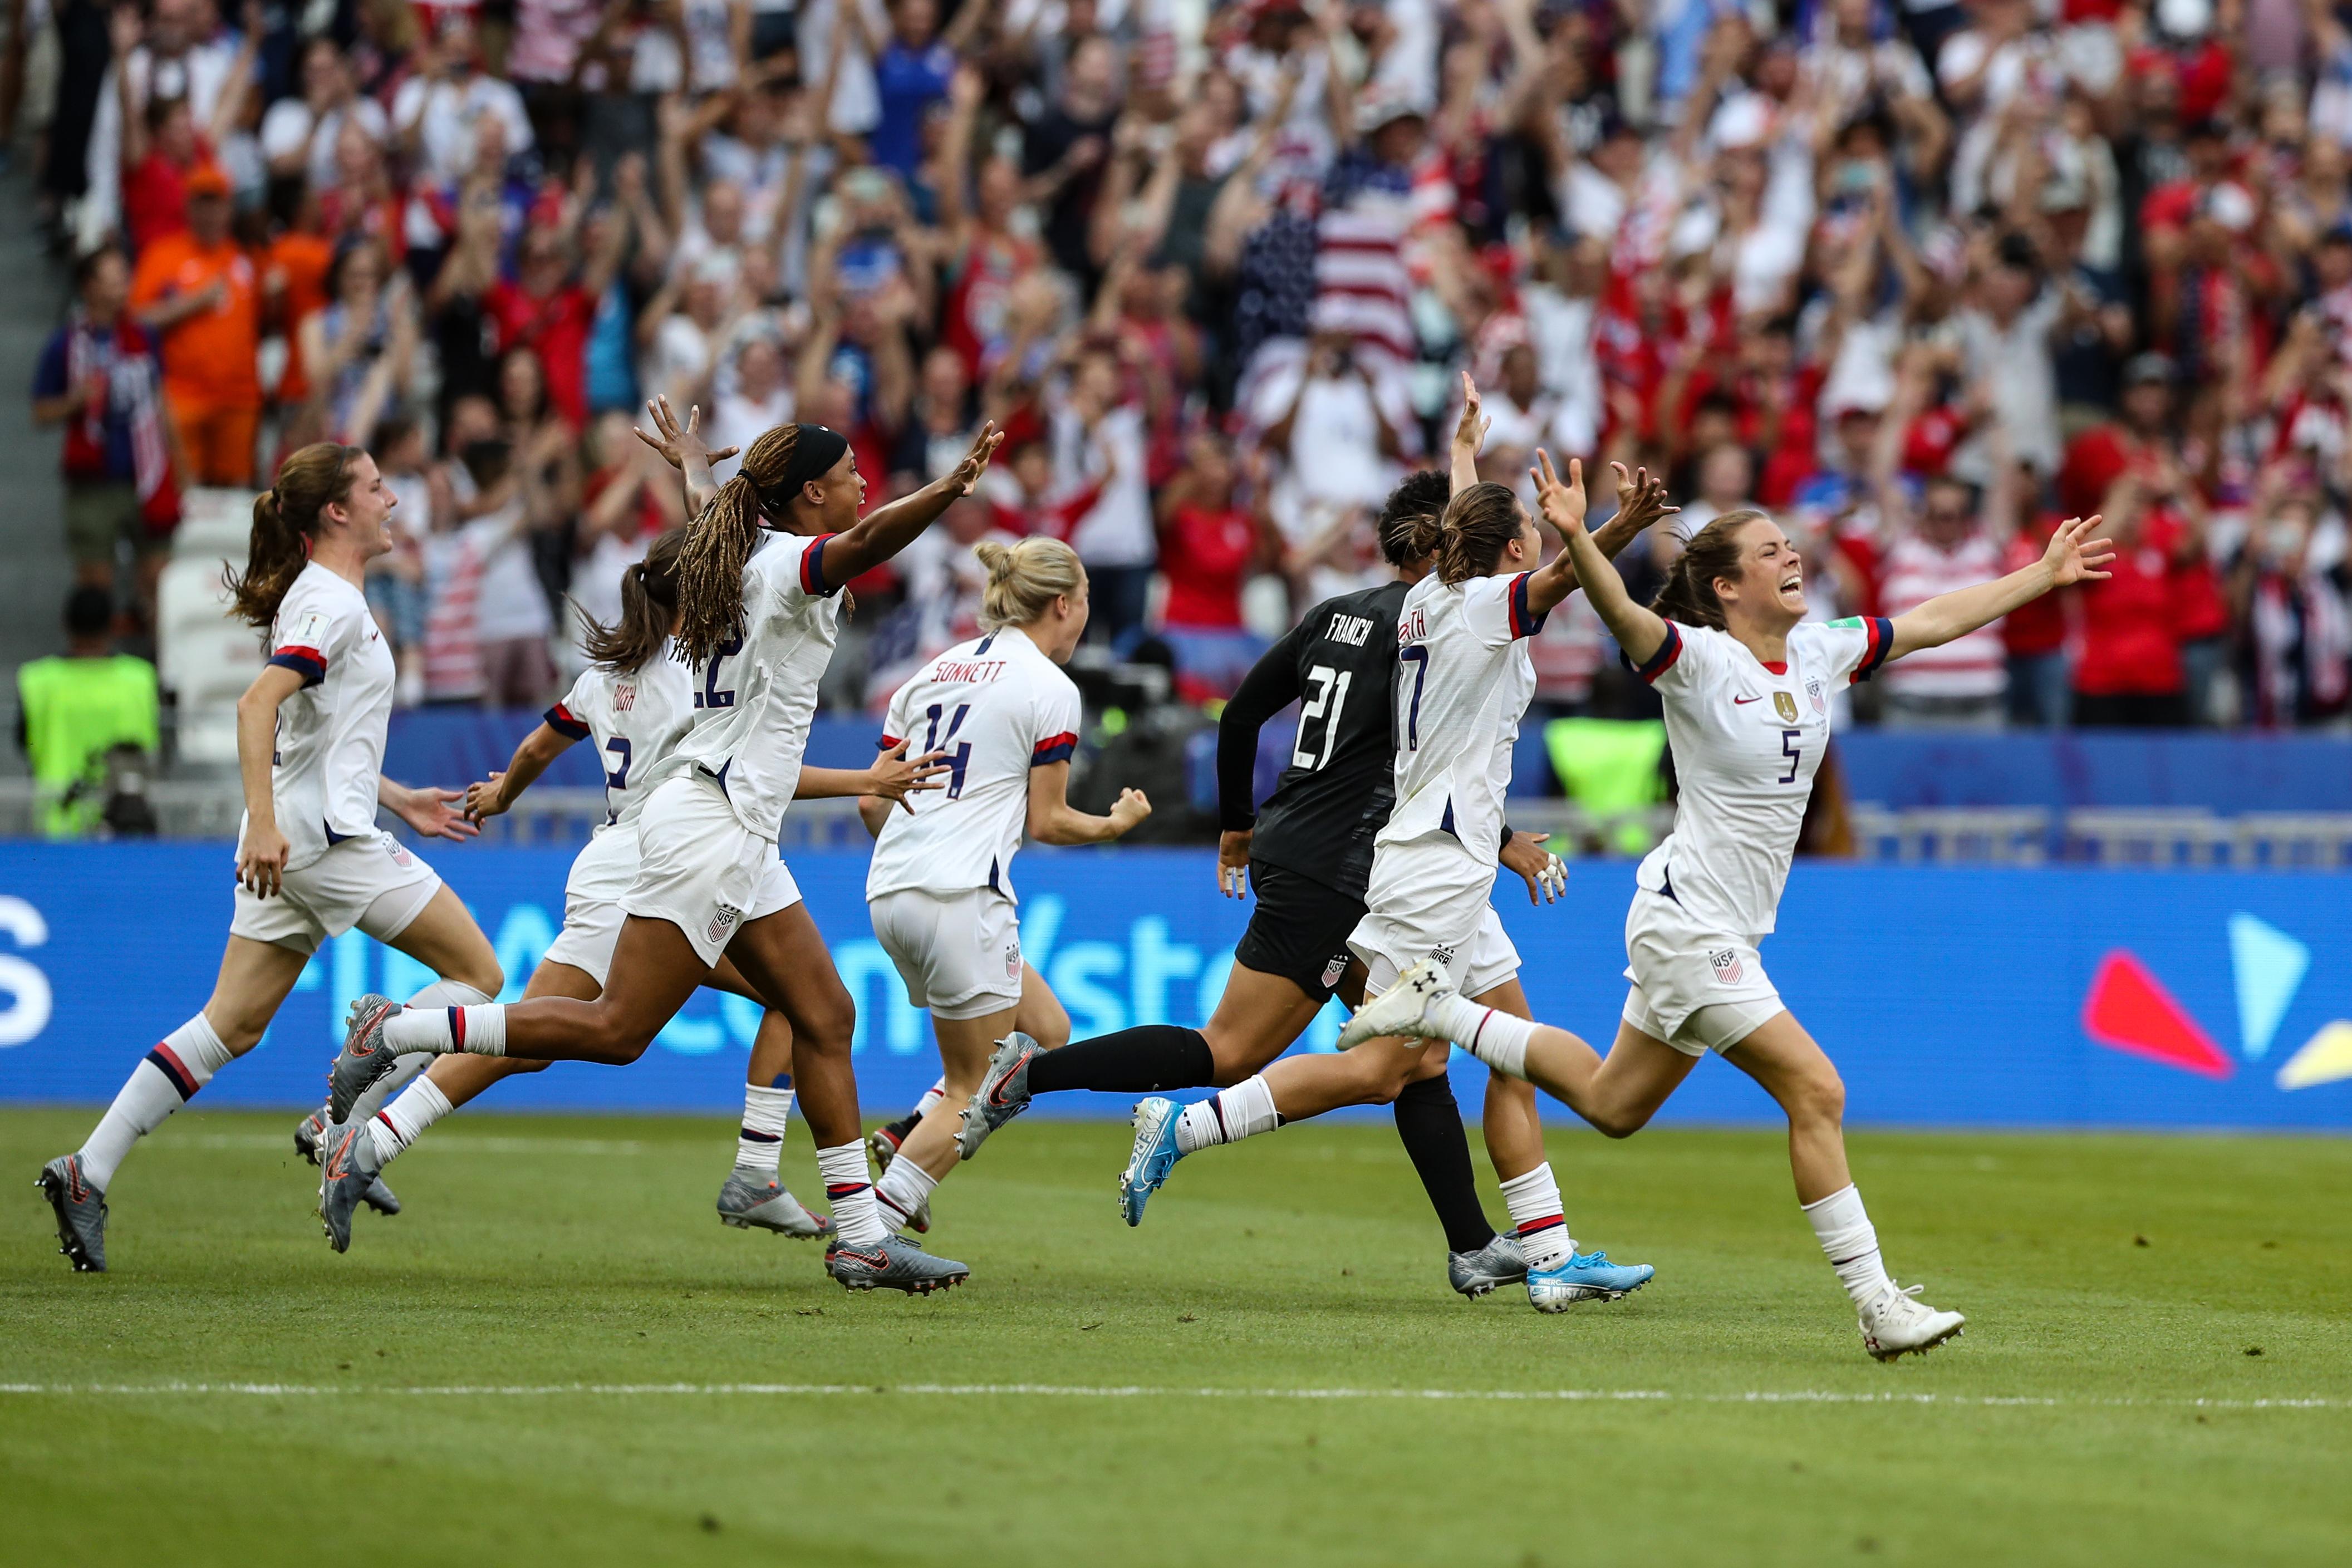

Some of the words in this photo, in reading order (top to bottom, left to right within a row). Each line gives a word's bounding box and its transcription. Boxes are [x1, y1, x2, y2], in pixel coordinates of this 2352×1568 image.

[1324, 612, 1374, 647] FRANCH
[931, 661, 1006, 683] SONNETT
[1292, 665, 1353, 771] 21
[912, 703, 972, 800] 14
[1778, 730, 1801, 784] 5
[718, 912, 735, 925] USA
[1329, 961, 1344, 973] USA
[1431, 951, 1450, 965] USA
[1713, 951, 1734, 967] USA
